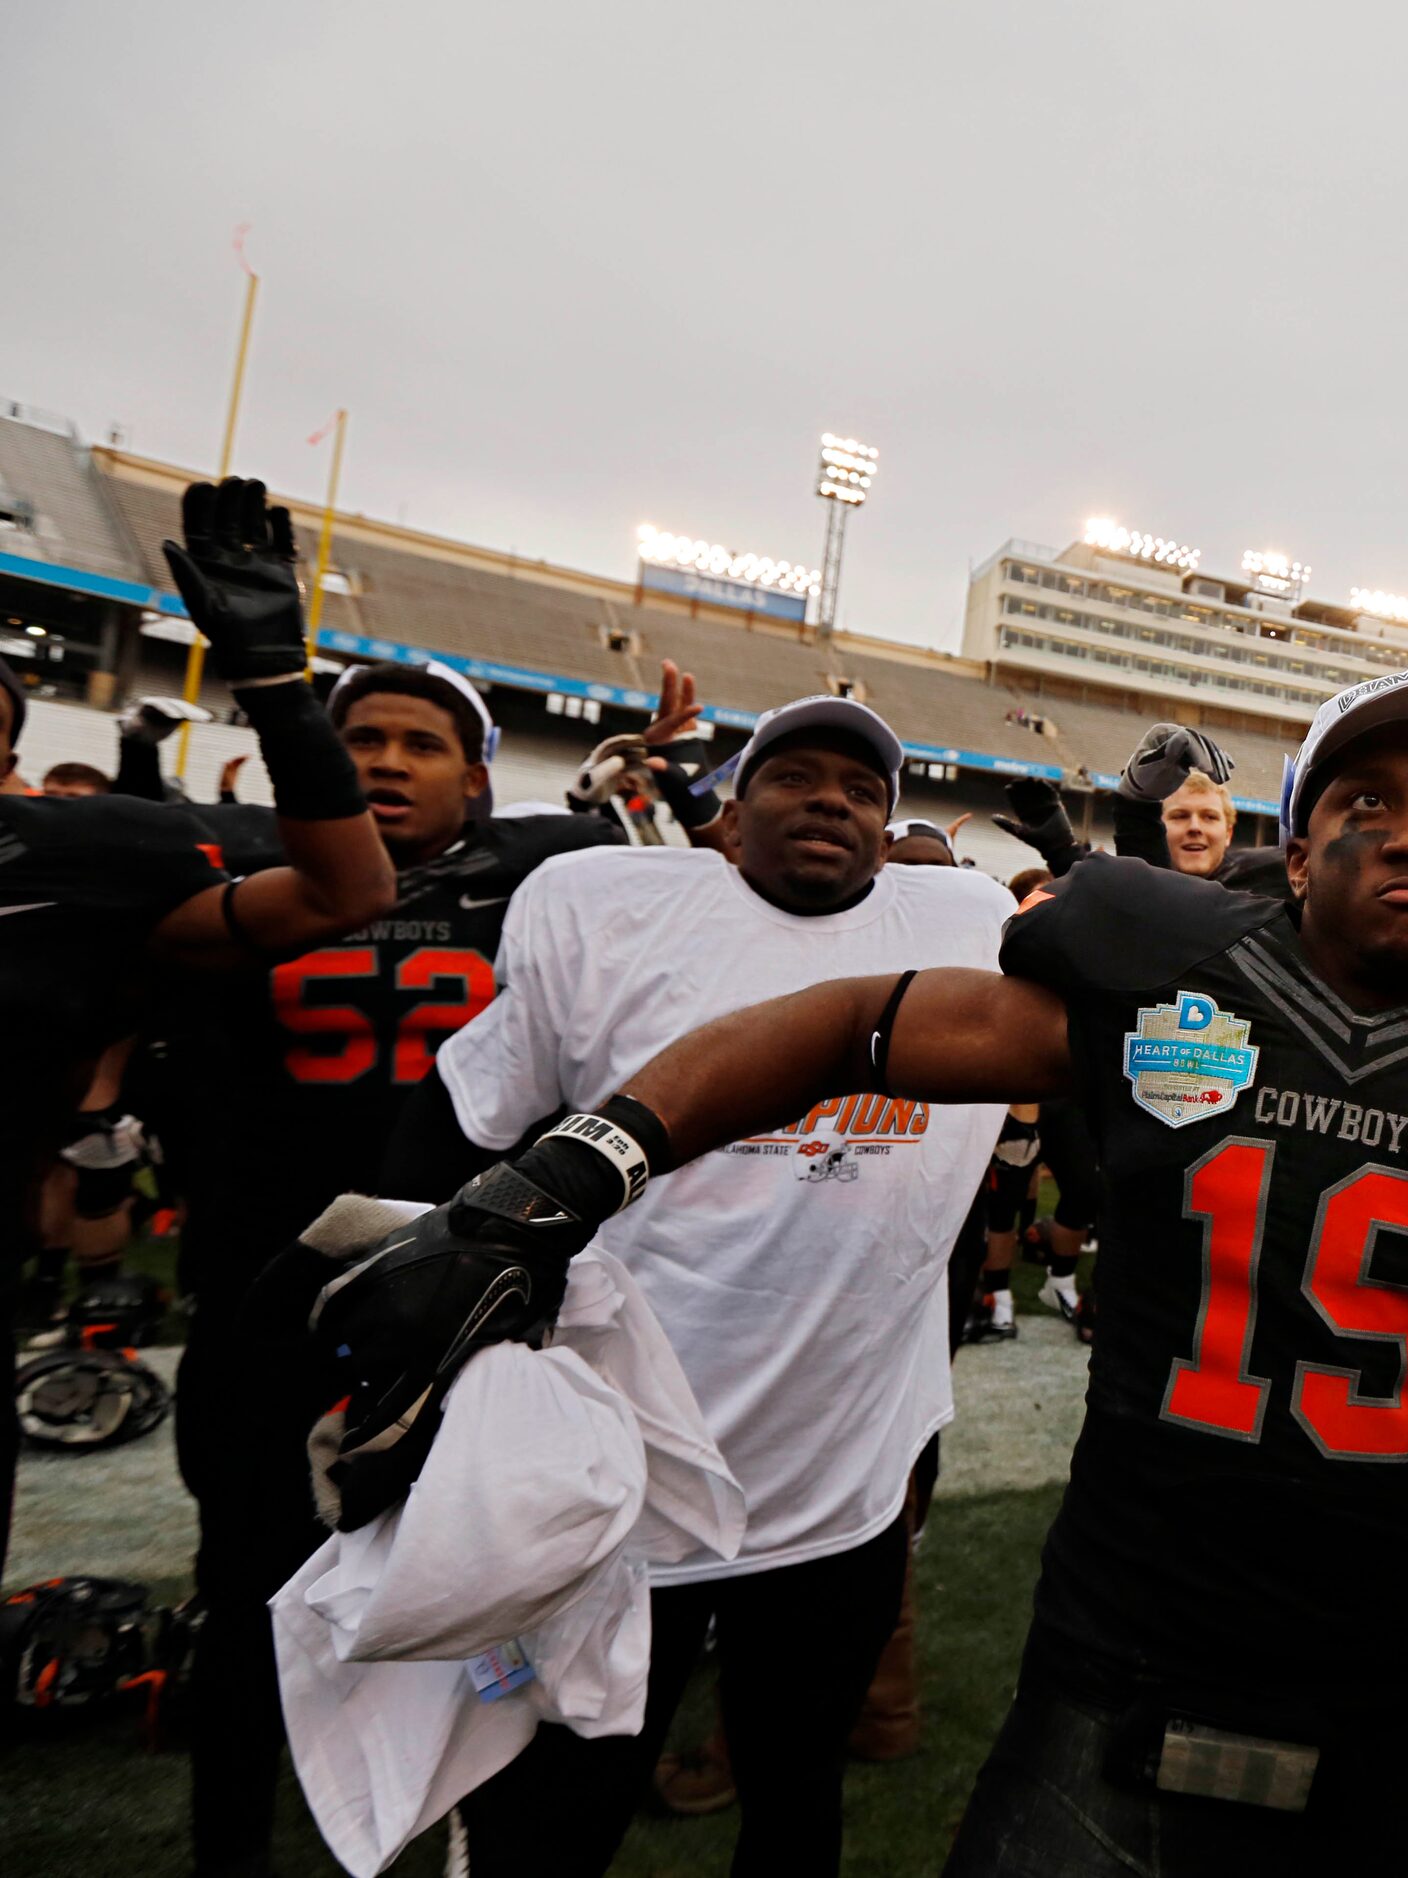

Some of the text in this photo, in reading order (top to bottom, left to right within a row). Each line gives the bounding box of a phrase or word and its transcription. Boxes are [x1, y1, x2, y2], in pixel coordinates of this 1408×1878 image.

[342, 920, 453, 941] OWBOYS
[271, 945, 497, 1084] 52
[1133, 1044, 1245, 1065] HEART OF DALLAS
[762, 1144, 789, 1156] STATE
[854, 1145, 890, 1156] COWBOYS
